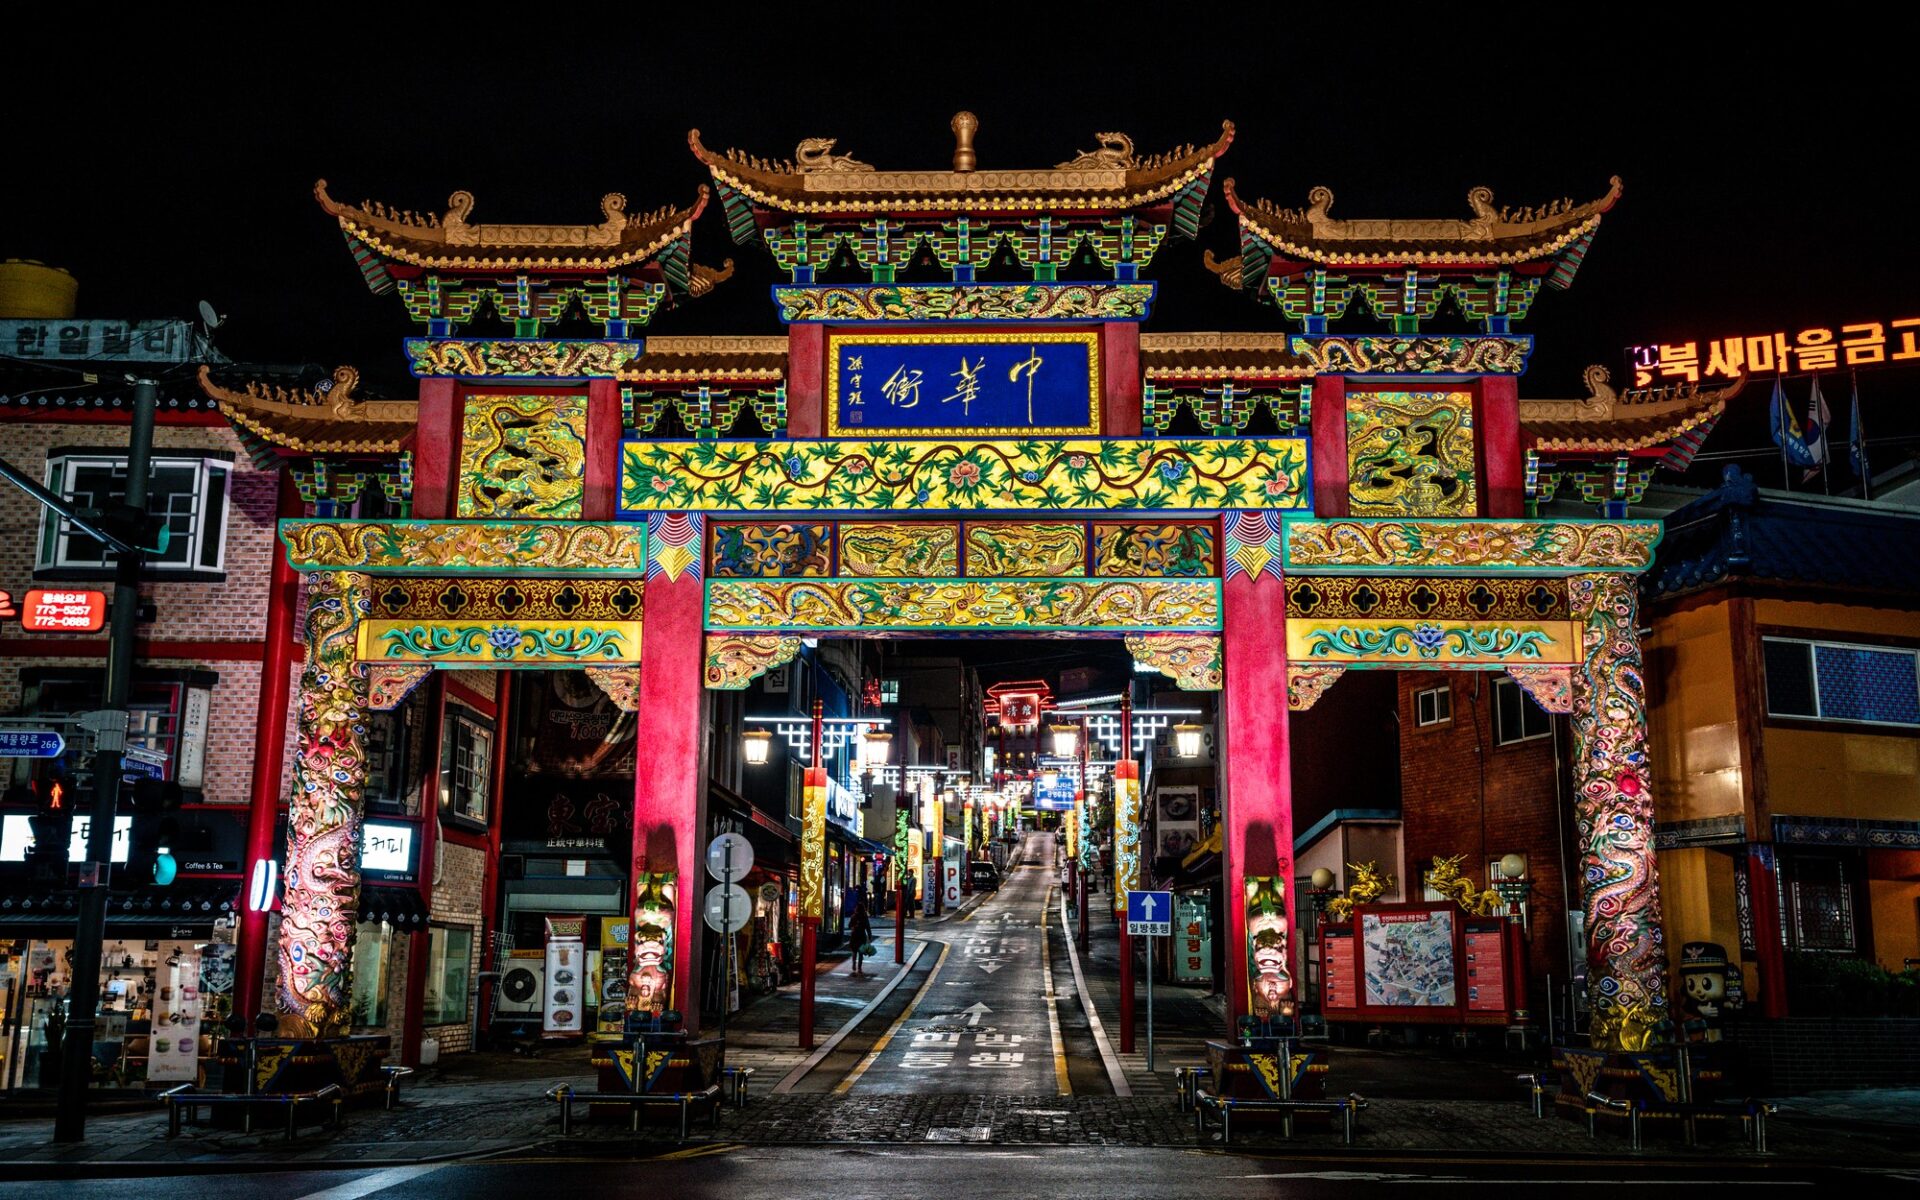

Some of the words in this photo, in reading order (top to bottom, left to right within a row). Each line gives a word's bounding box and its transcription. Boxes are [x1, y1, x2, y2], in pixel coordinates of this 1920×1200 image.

[40, 740, 57, 749] 266
[185, 861, 205, 870] Coffee
[205, 862, 211, 870] &
[212, 862, 223, 870] Tea
[1129, 923, 1169, 933] 일방통행
